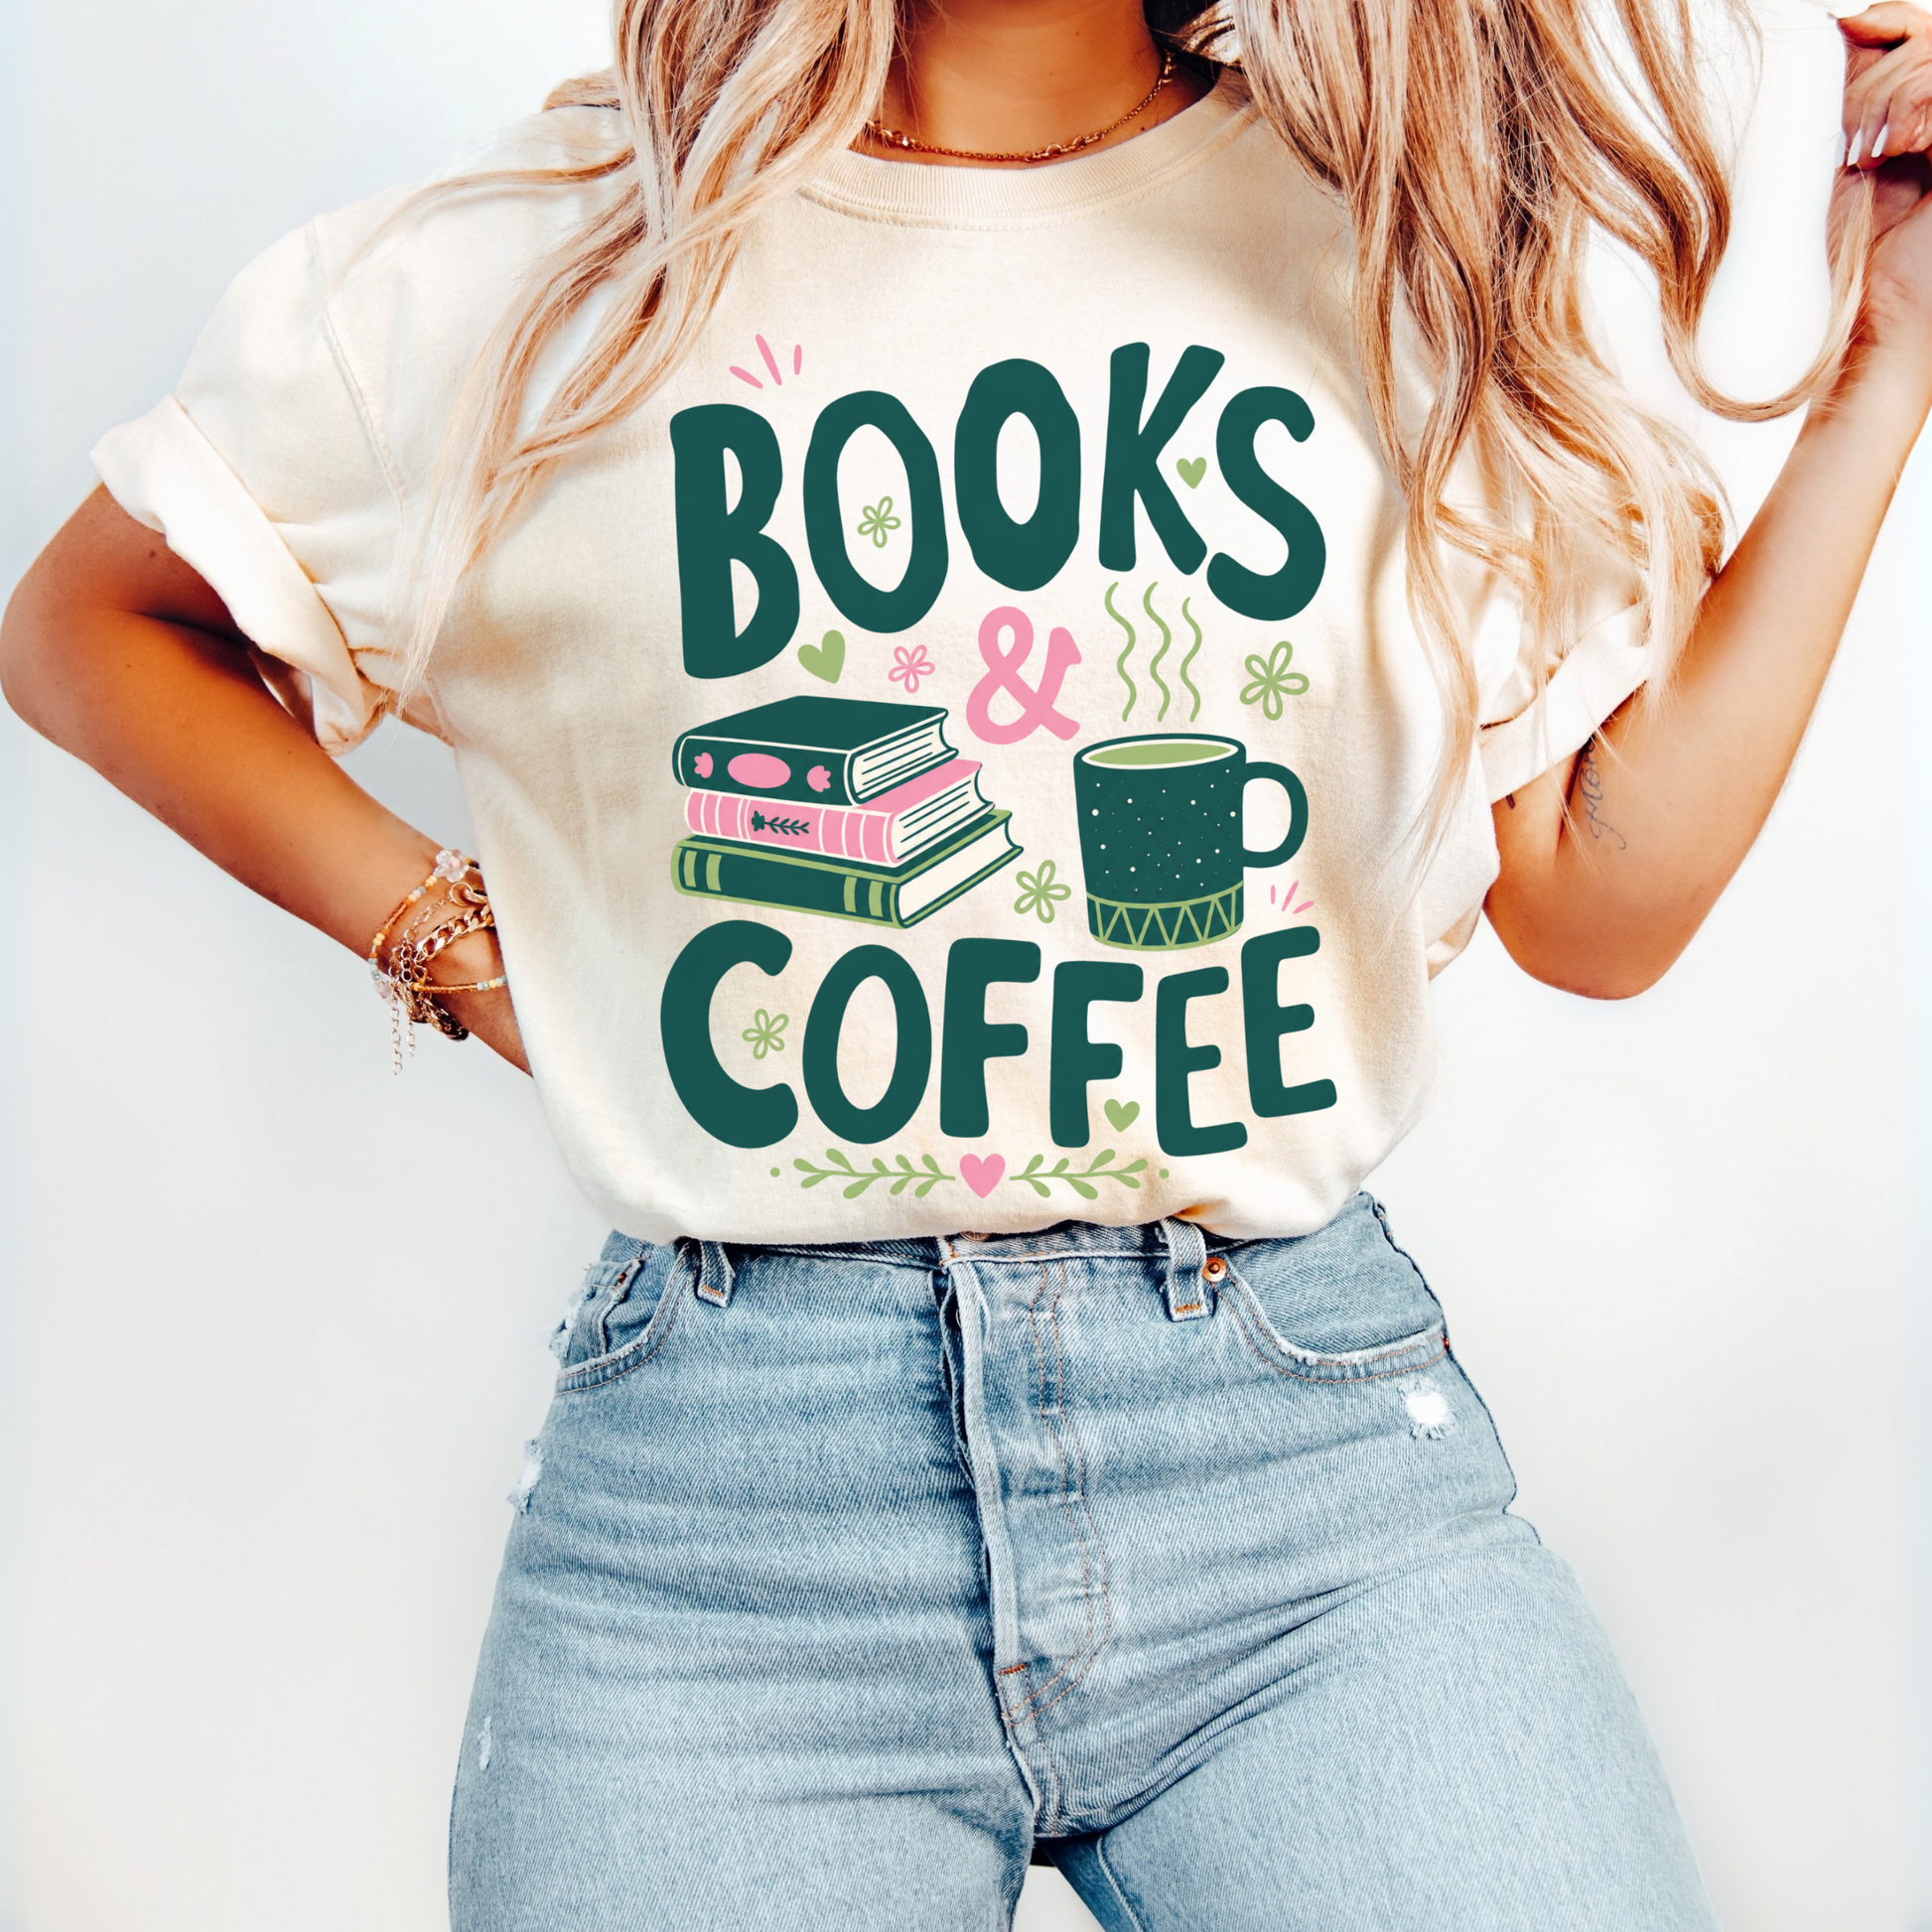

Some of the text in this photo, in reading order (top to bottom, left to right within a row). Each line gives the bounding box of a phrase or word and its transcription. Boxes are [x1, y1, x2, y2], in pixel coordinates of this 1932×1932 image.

[670, 343, 1325, 679] BOOKS
[966, 607, 1081, 745] &
[661, 920, 1336, 1157] COFFEE
